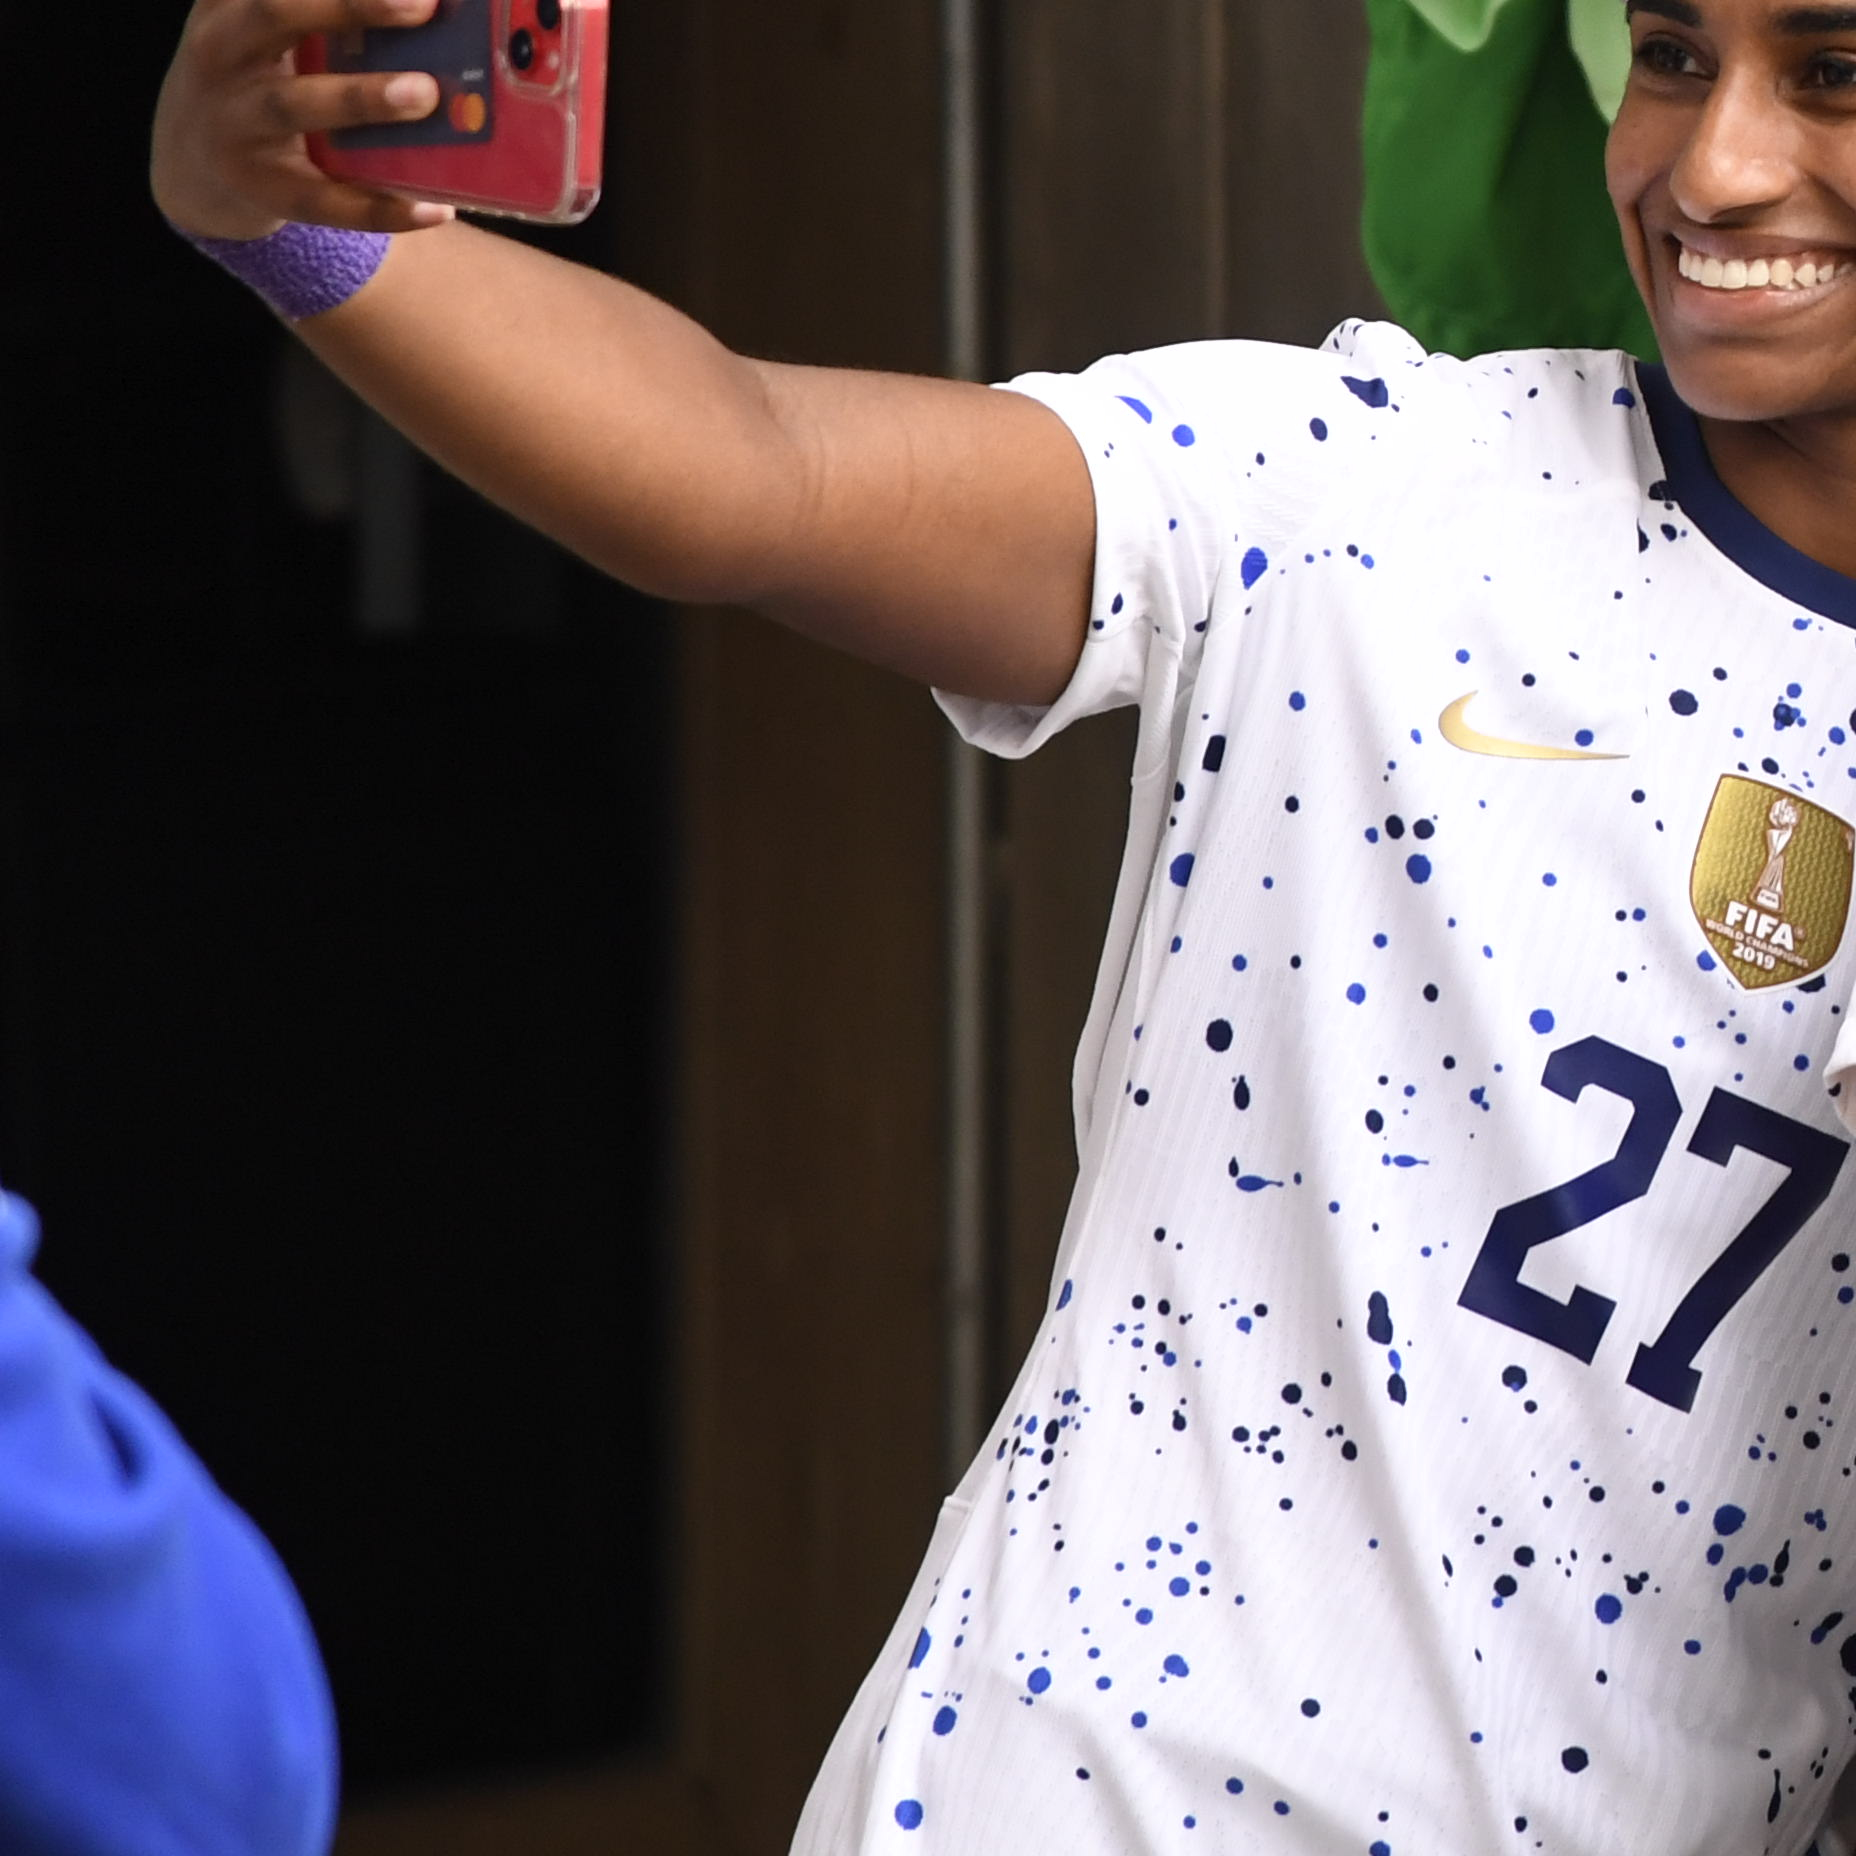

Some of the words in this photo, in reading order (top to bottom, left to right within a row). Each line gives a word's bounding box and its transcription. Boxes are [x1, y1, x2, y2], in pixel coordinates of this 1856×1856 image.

[1705, 918, 1745, 942] WORLD
[1745, 936, 1810, 969] CHAMPIONS
[1724, 900, 1794, 952] FIFA
[1731, 941, 1776, 971] 2019
[1457, 1034, 1851, 1414] 27
